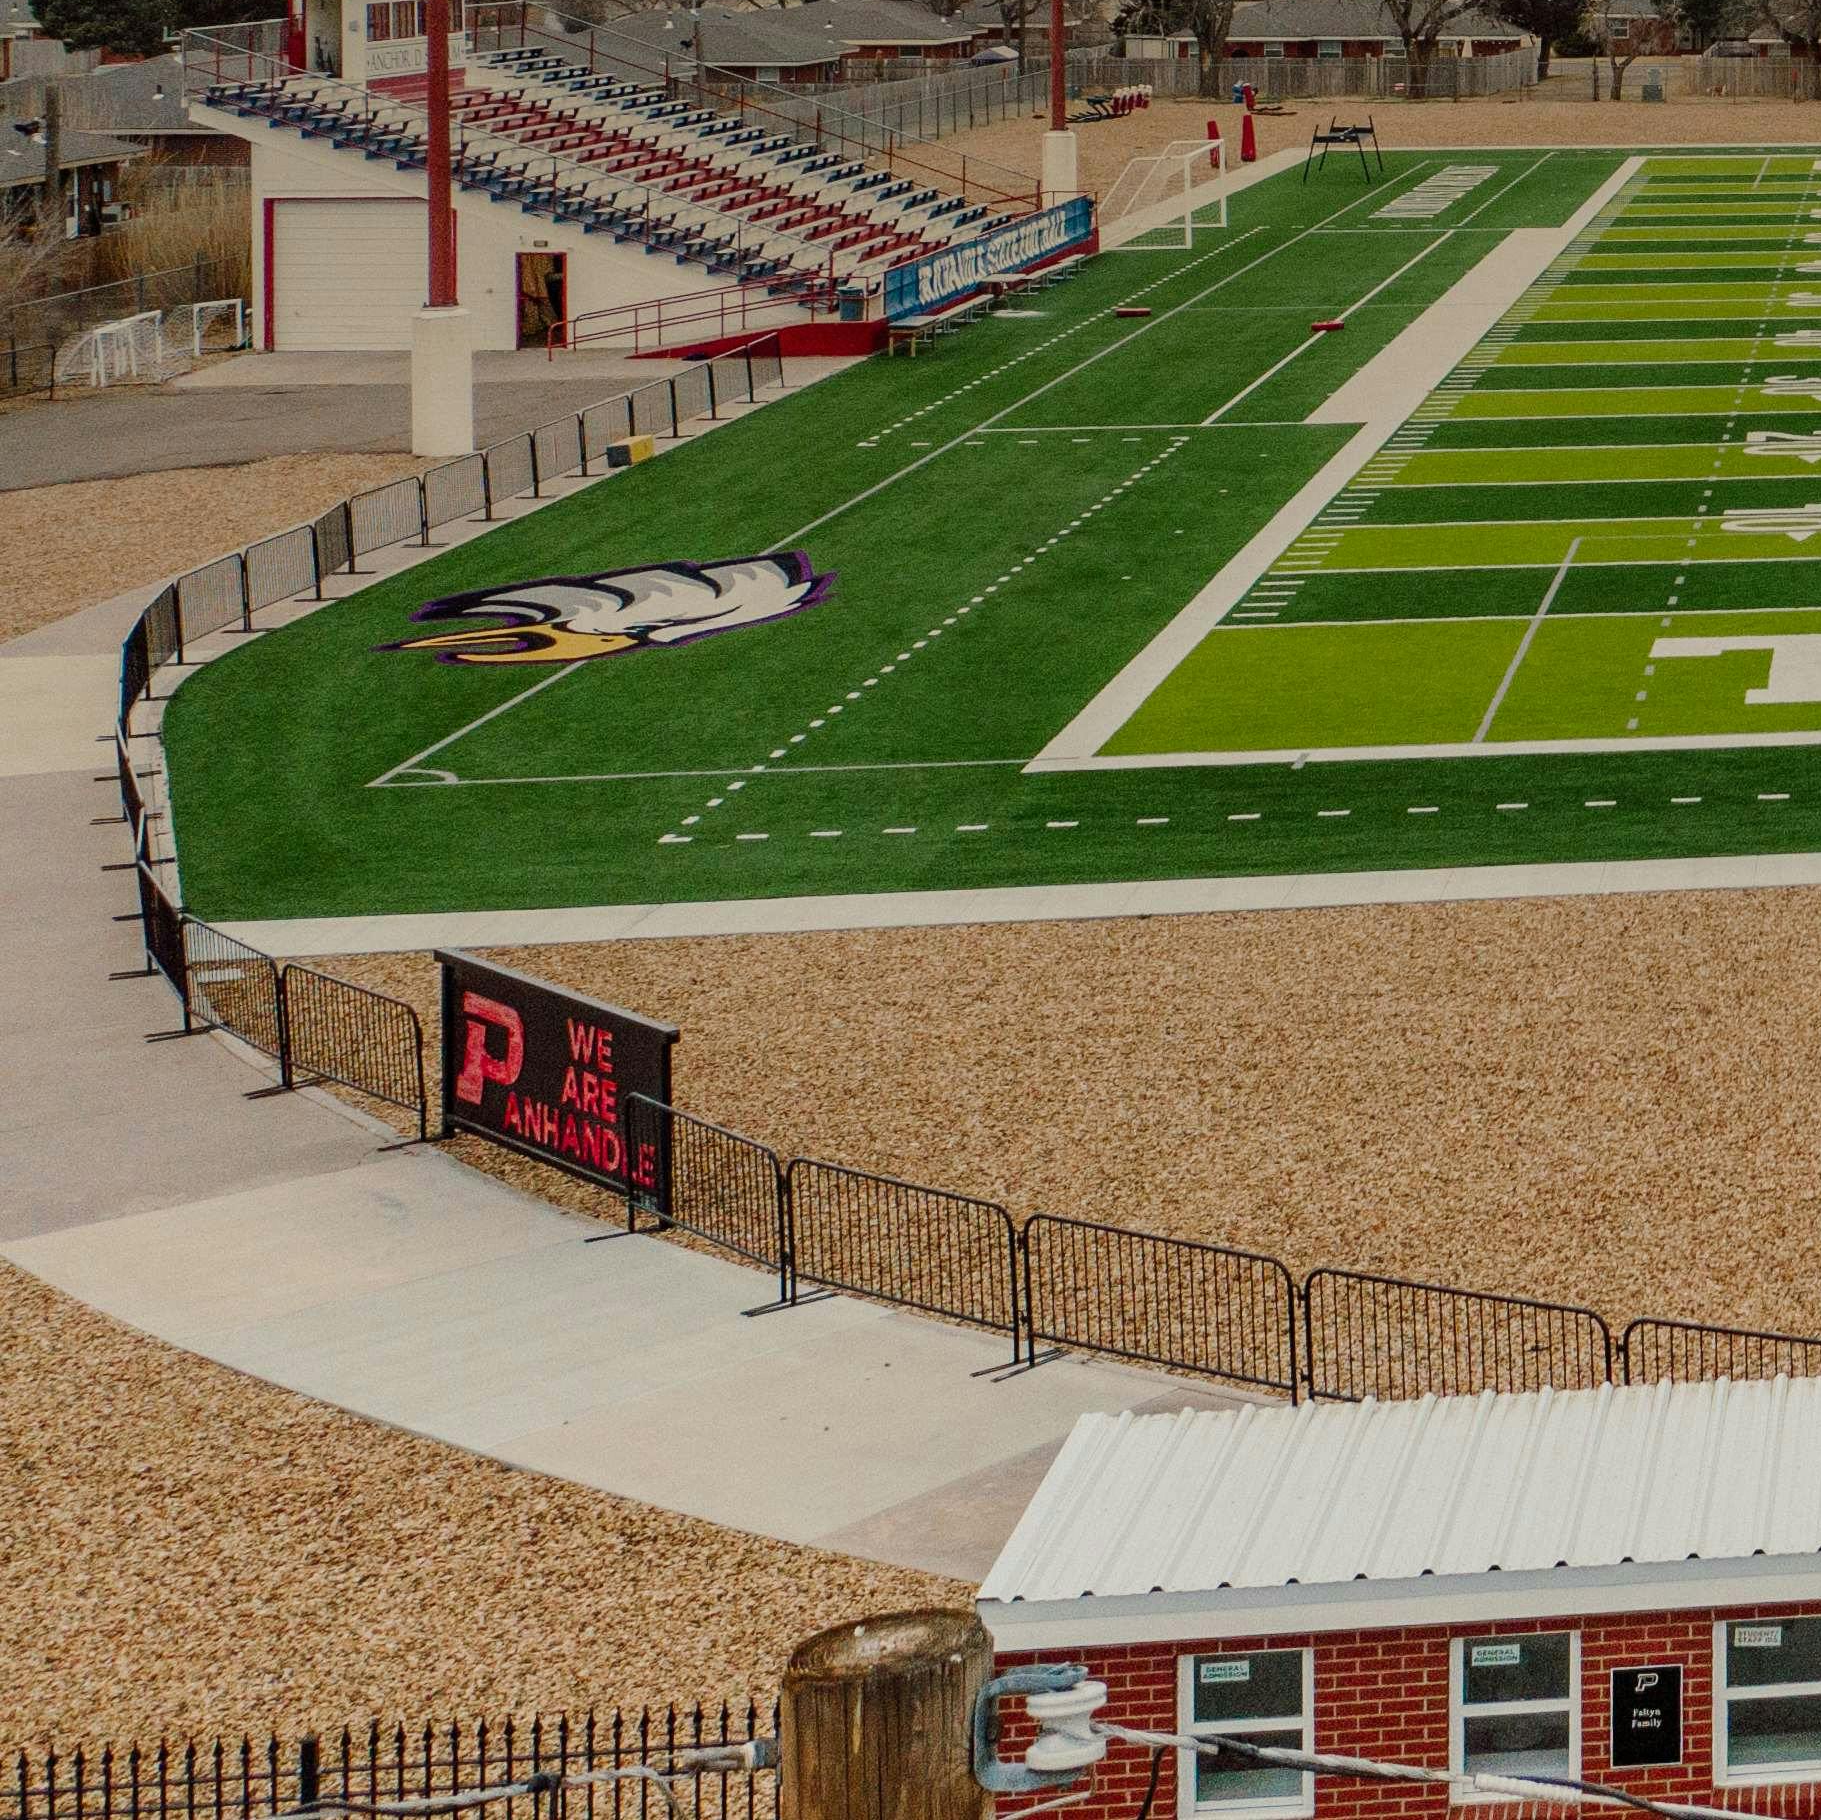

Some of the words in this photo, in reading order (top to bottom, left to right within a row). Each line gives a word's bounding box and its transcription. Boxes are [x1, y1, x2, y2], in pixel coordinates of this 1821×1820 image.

[567, 1018, 613, 1074] WE
[561, 1066, 618, 1124] ARE
[1635, 1673, 1659, 1692] P
[1631, 1718, 1662, 1729] Family
